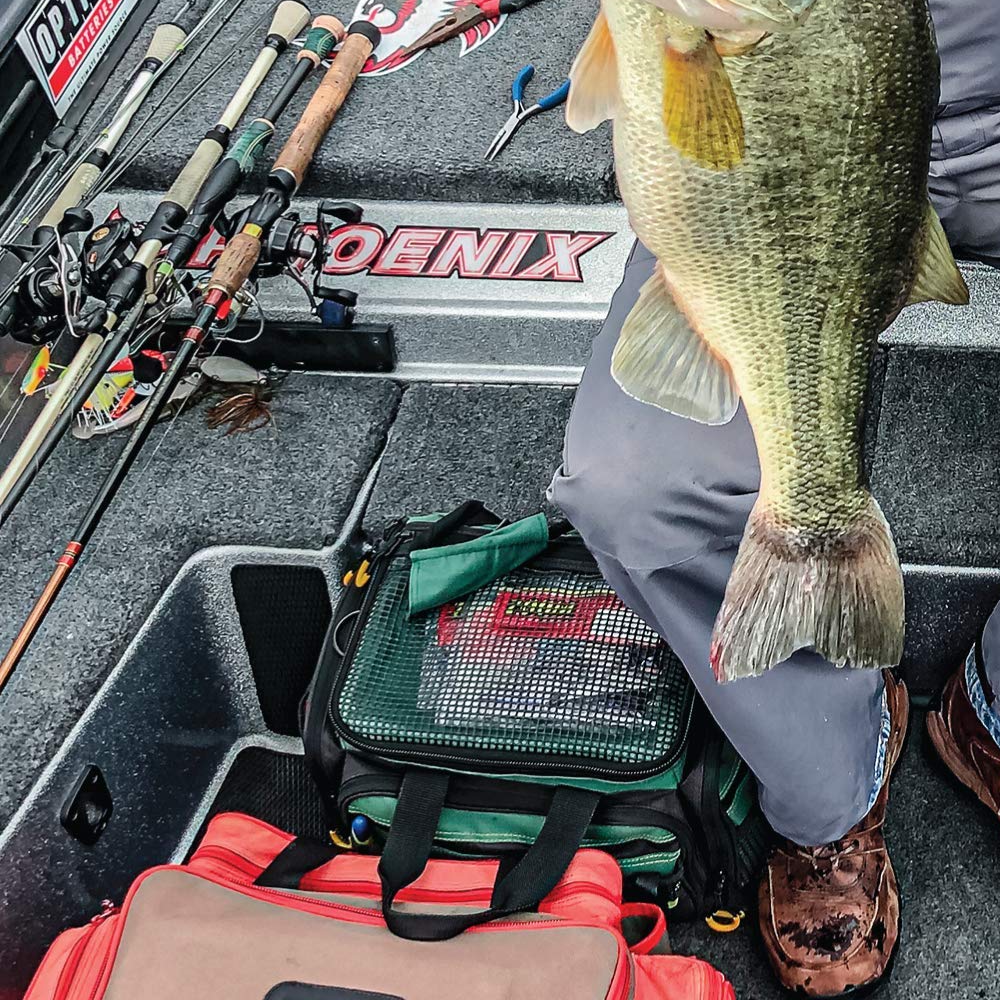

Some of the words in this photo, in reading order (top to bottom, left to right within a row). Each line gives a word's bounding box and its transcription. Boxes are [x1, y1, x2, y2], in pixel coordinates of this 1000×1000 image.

[68, 88, 77, 102] THE
[77, 58, 97, 88] ULTIMATE
[96, 35, 111, 57] POWER
[111, 10, 127, 34] SOURCE
